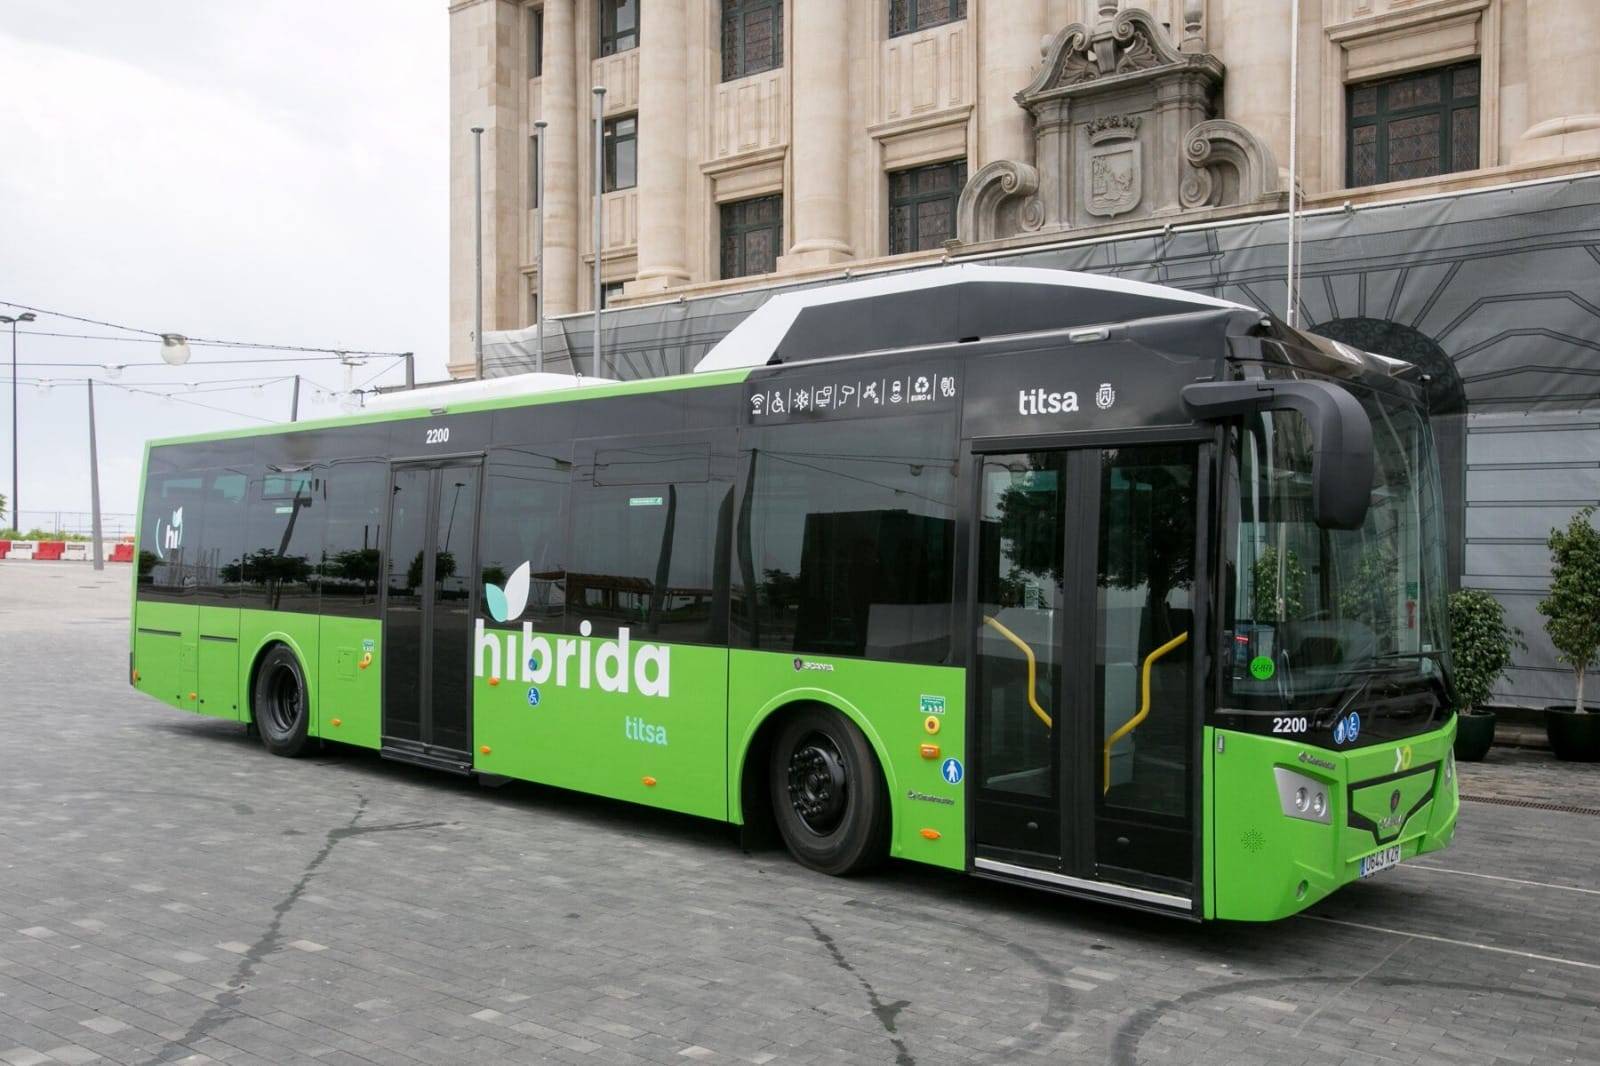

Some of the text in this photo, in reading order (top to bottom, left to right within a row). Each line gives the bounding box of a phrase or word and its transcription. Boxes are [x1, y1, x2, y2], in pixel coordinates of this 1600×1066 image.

[1018, 387, 1079, 416] titsa
[426, 427, 450, 444] 2200
[625, 715, 668, 746] titsa
[1272, 717, 1307, 733] 2200
[1366, 850, 1384, 872] 0643
